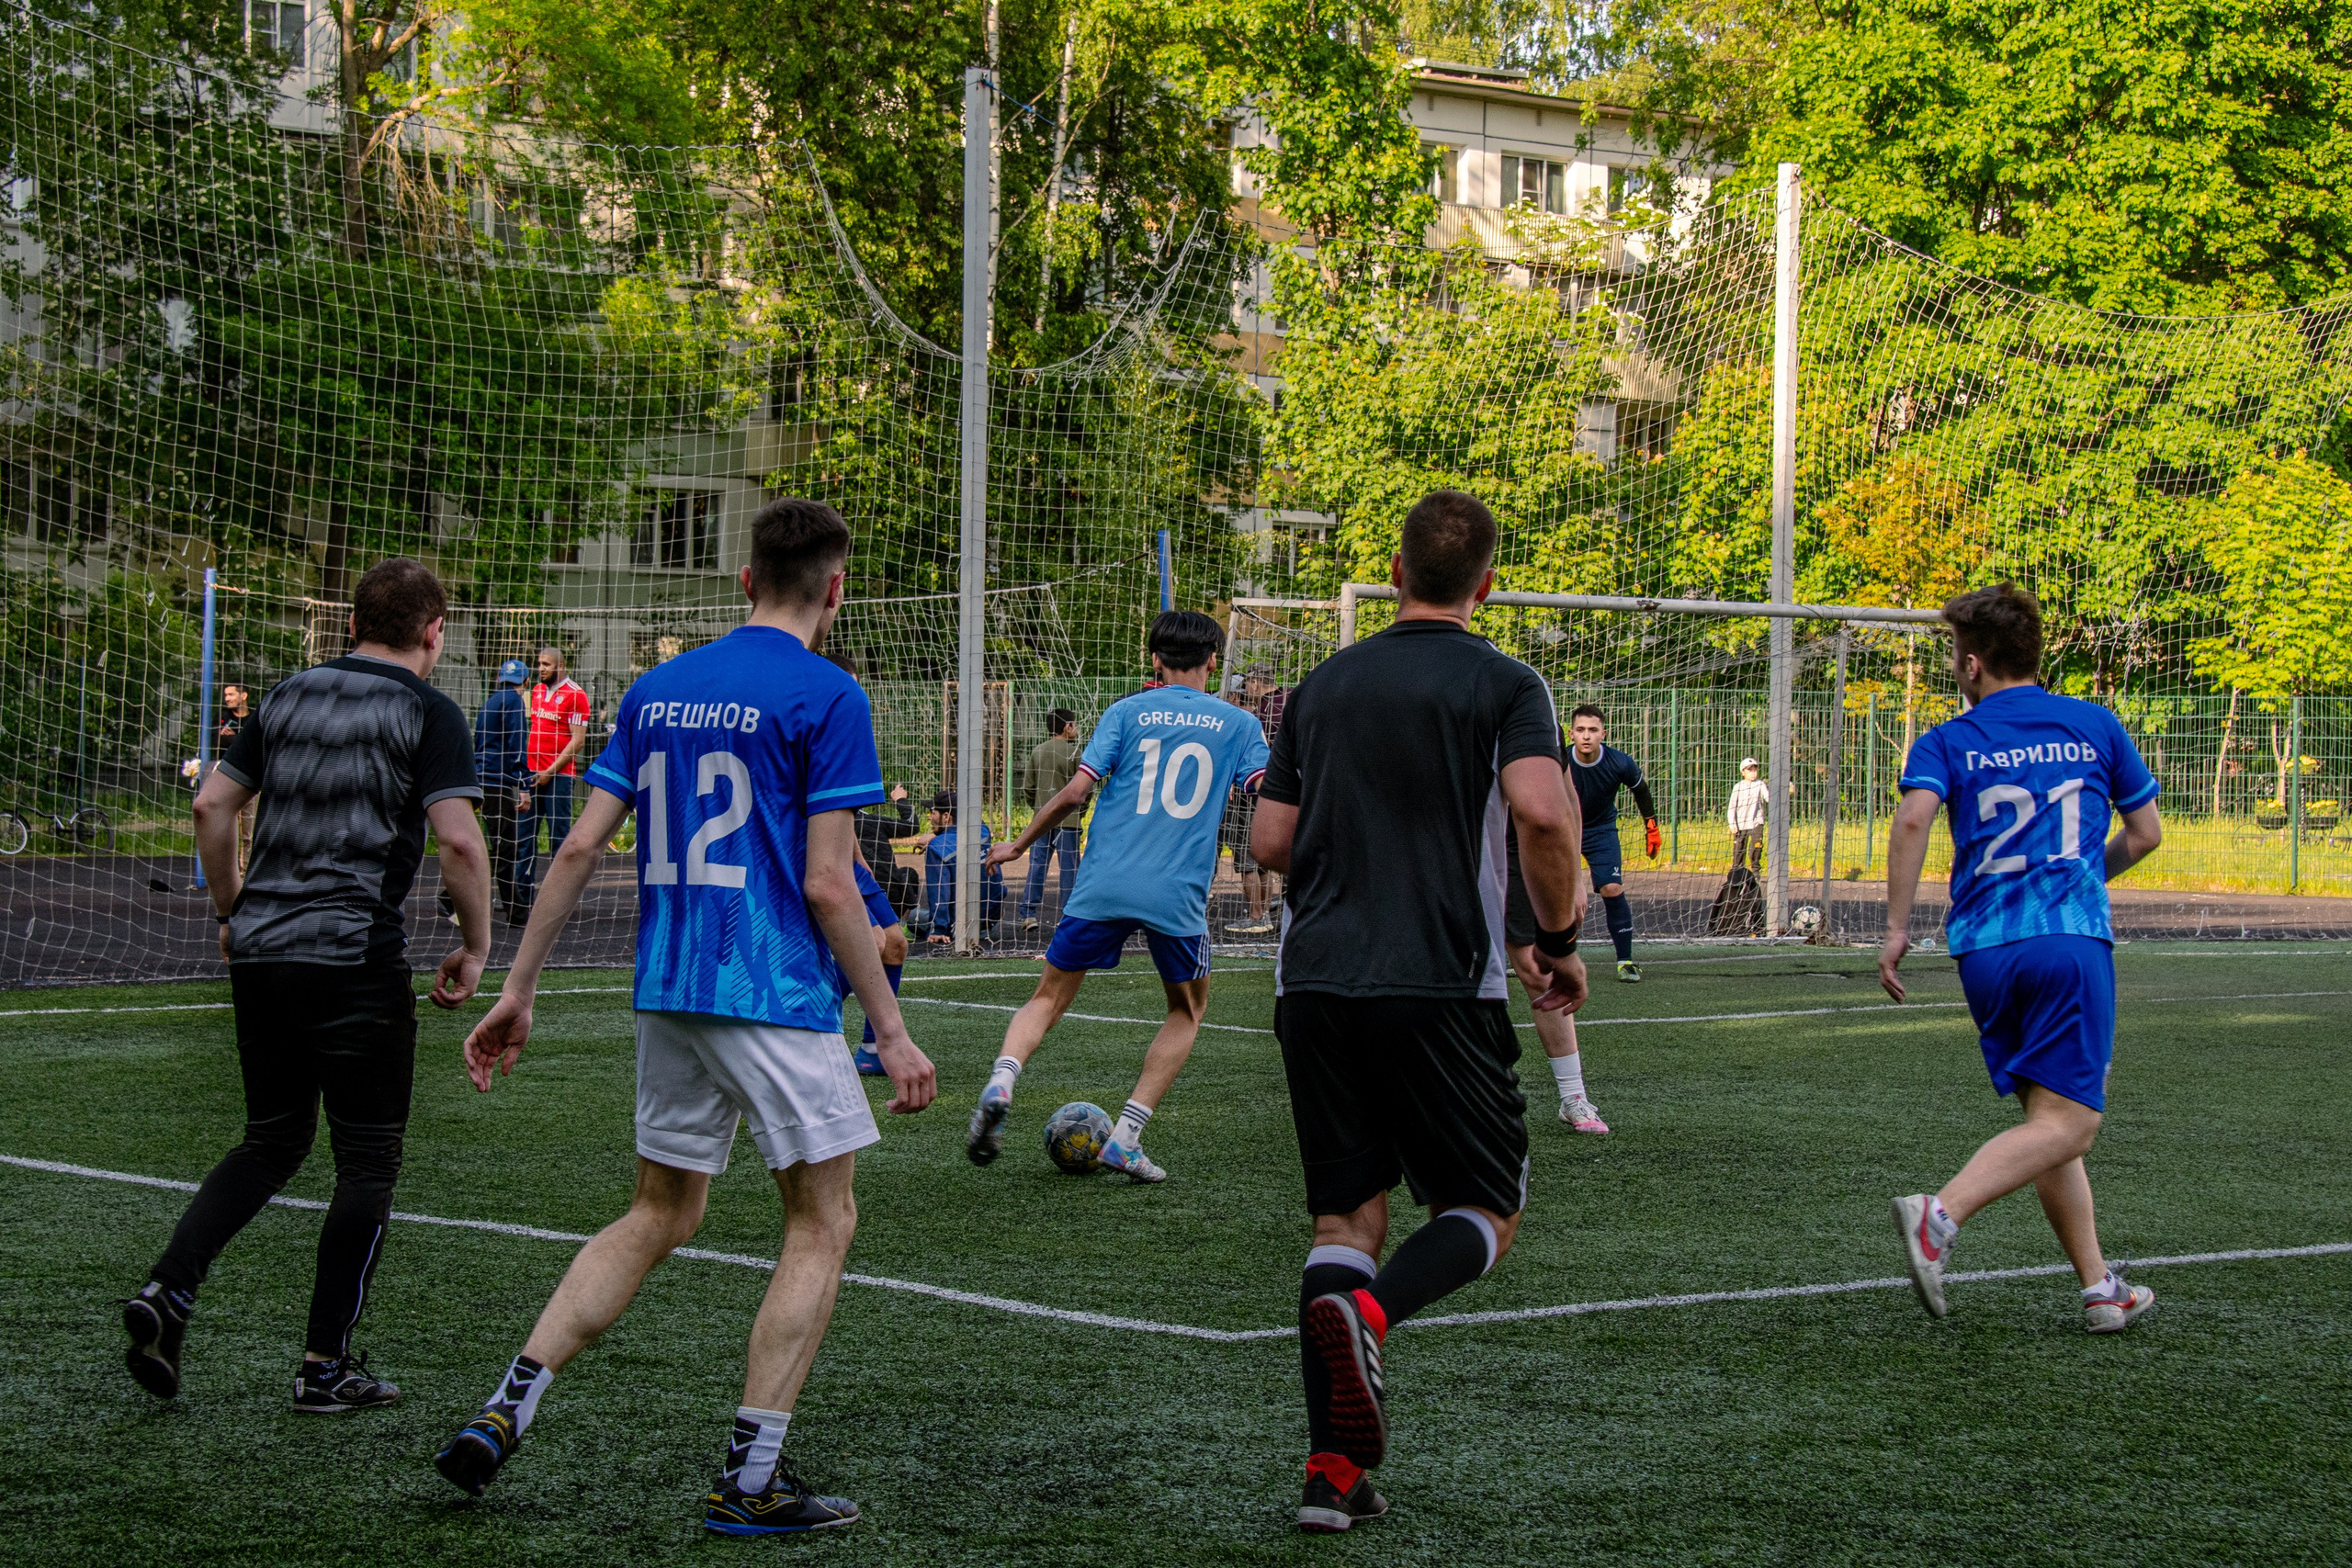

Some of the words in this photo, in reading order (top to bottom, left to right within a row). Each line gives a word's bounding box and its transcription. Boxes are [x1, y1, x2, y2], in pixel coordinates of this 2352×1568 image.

[639, 702, 760, 733] ГРЕШНОВ
[1138, 711, 1224, 732] GREALISH
[1136, 739, 1213, 818] 10
[1966, 742, 2097, 771] ГАВРИЛОВ
[637, 751, 752, 888] 12
[1974, 778, 2084, 876] 21
